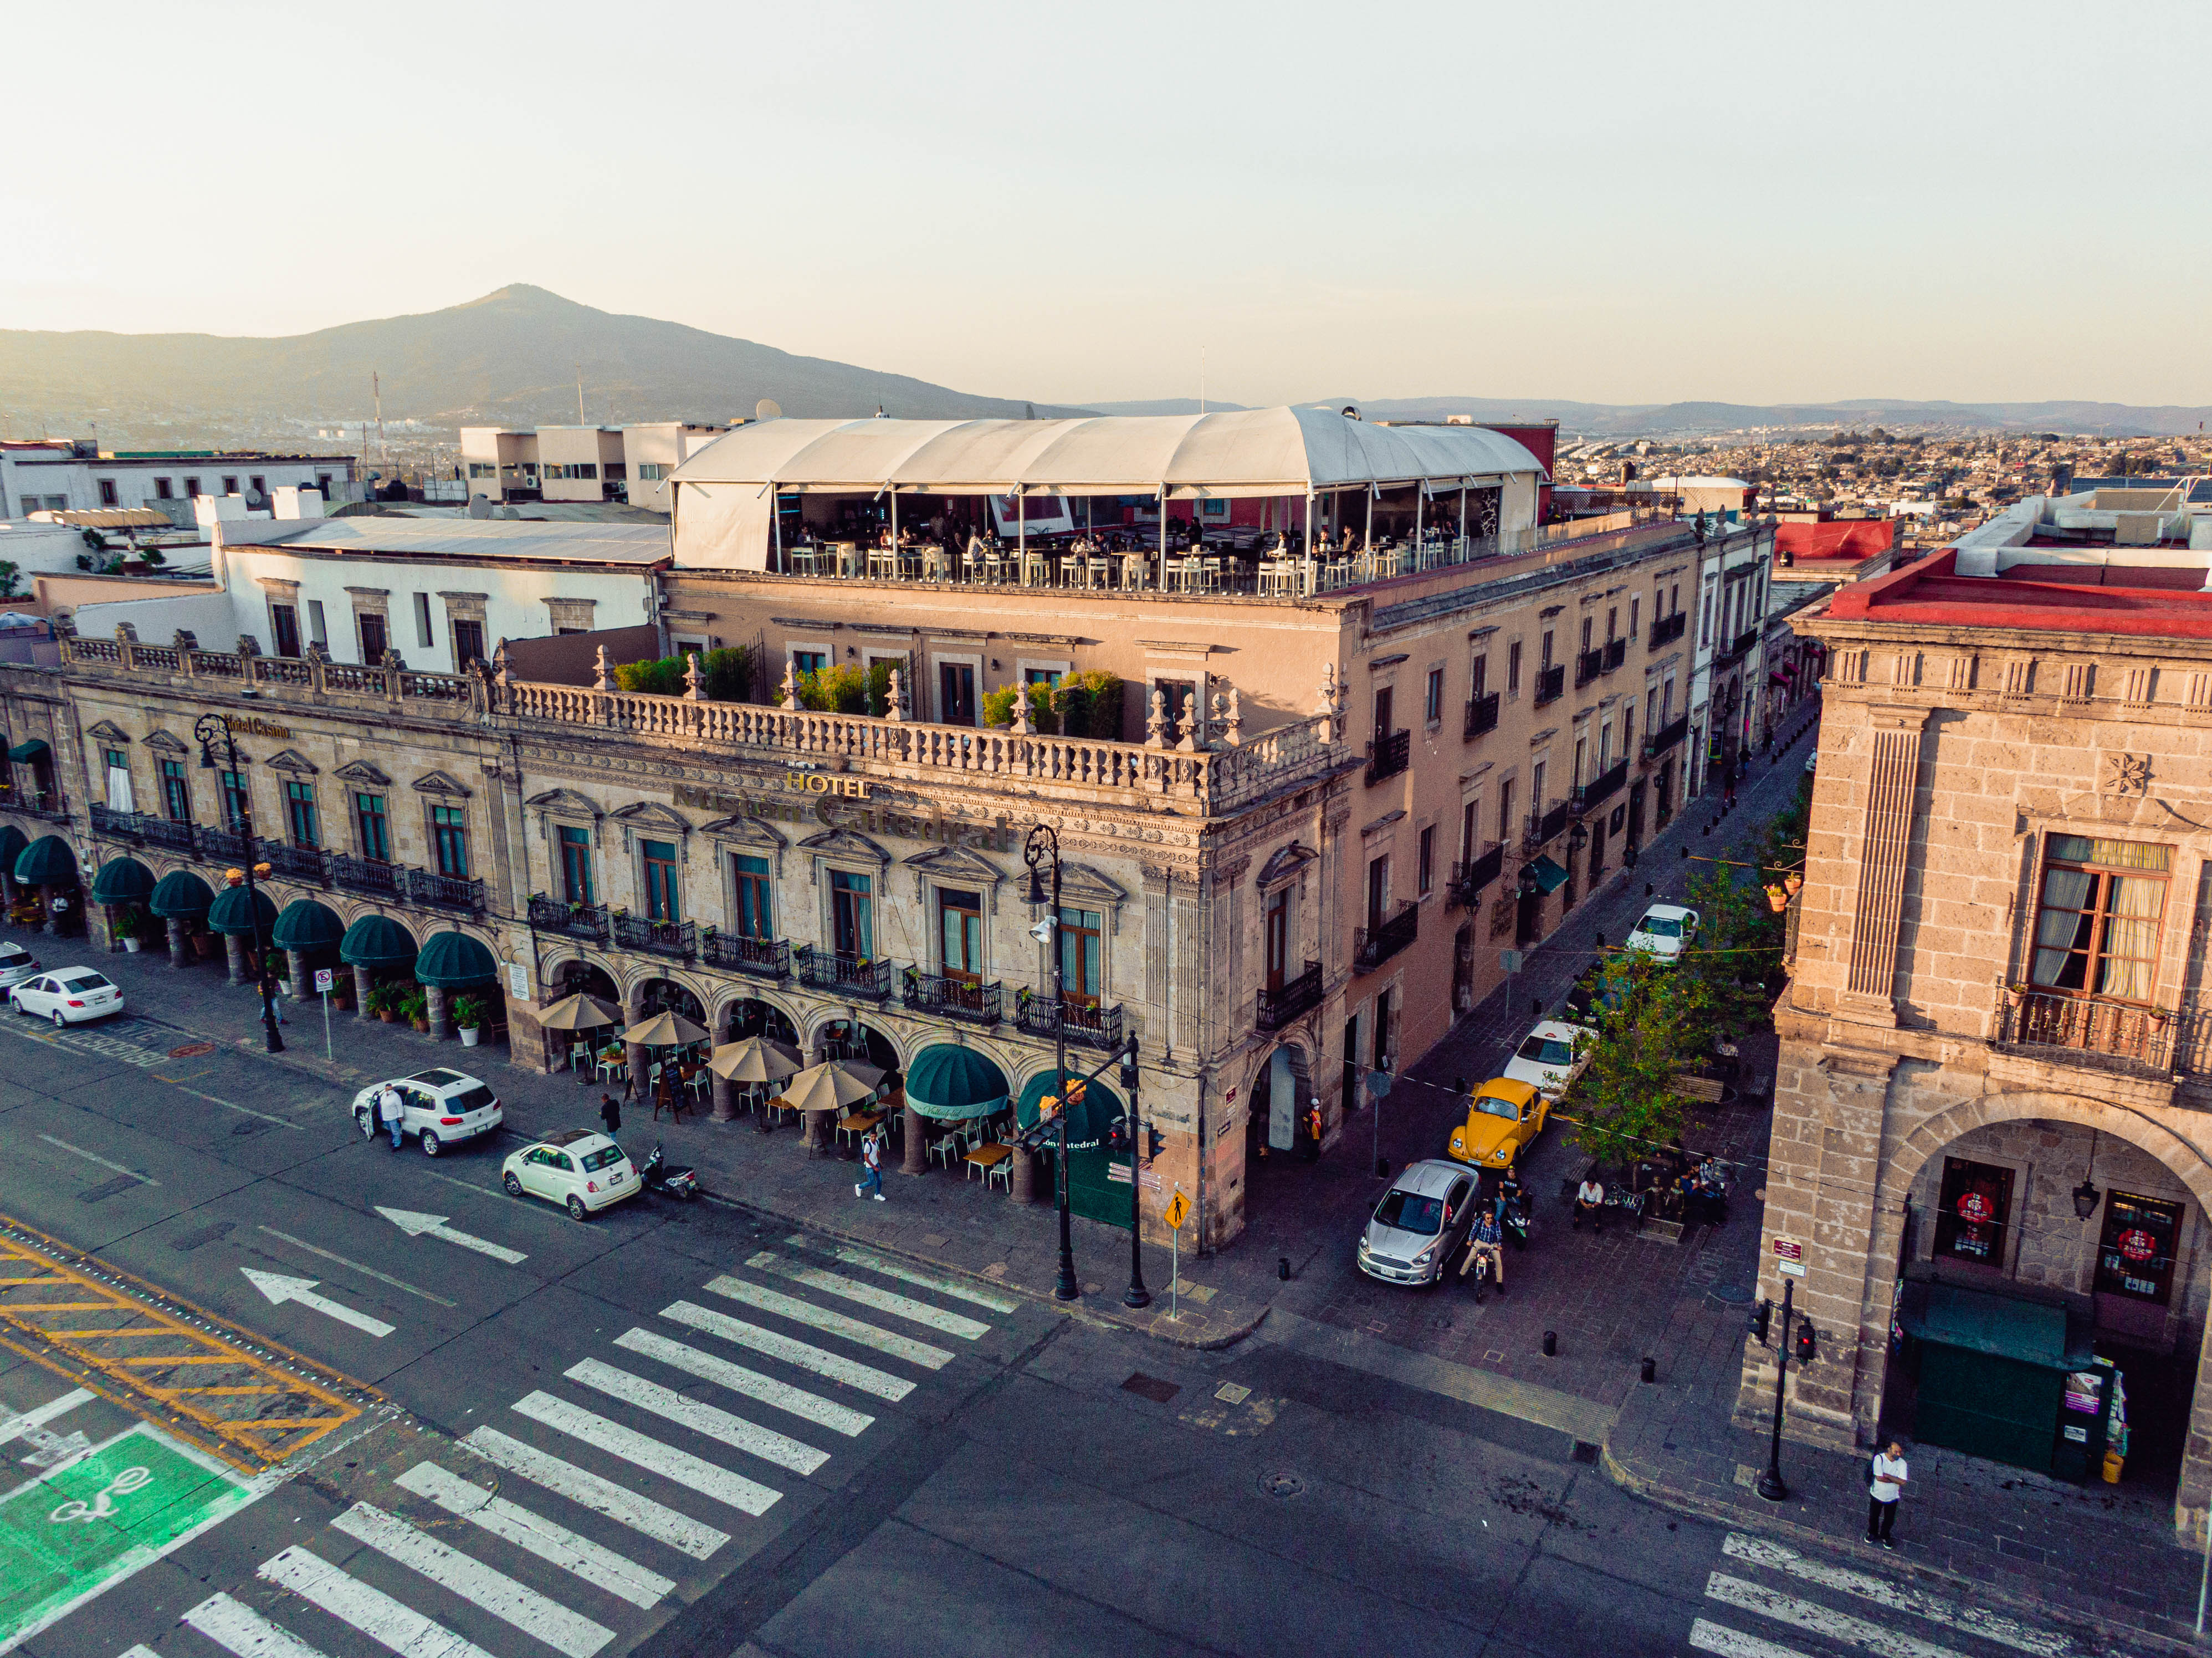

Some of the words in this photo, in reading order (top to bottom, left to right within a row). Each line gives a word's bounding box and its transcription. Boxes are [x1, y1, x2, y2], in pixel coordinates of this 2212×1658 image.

[223, 713, 253, 734] Hotel
[254, 718, 290, 739] Casino
[787, 772, 871, 799] HOTEL
[672, 782, 802, 822] Misión
[815, 795, 1008, 852] Catedral
[1058, 1139, 1099, 1149] tedral
